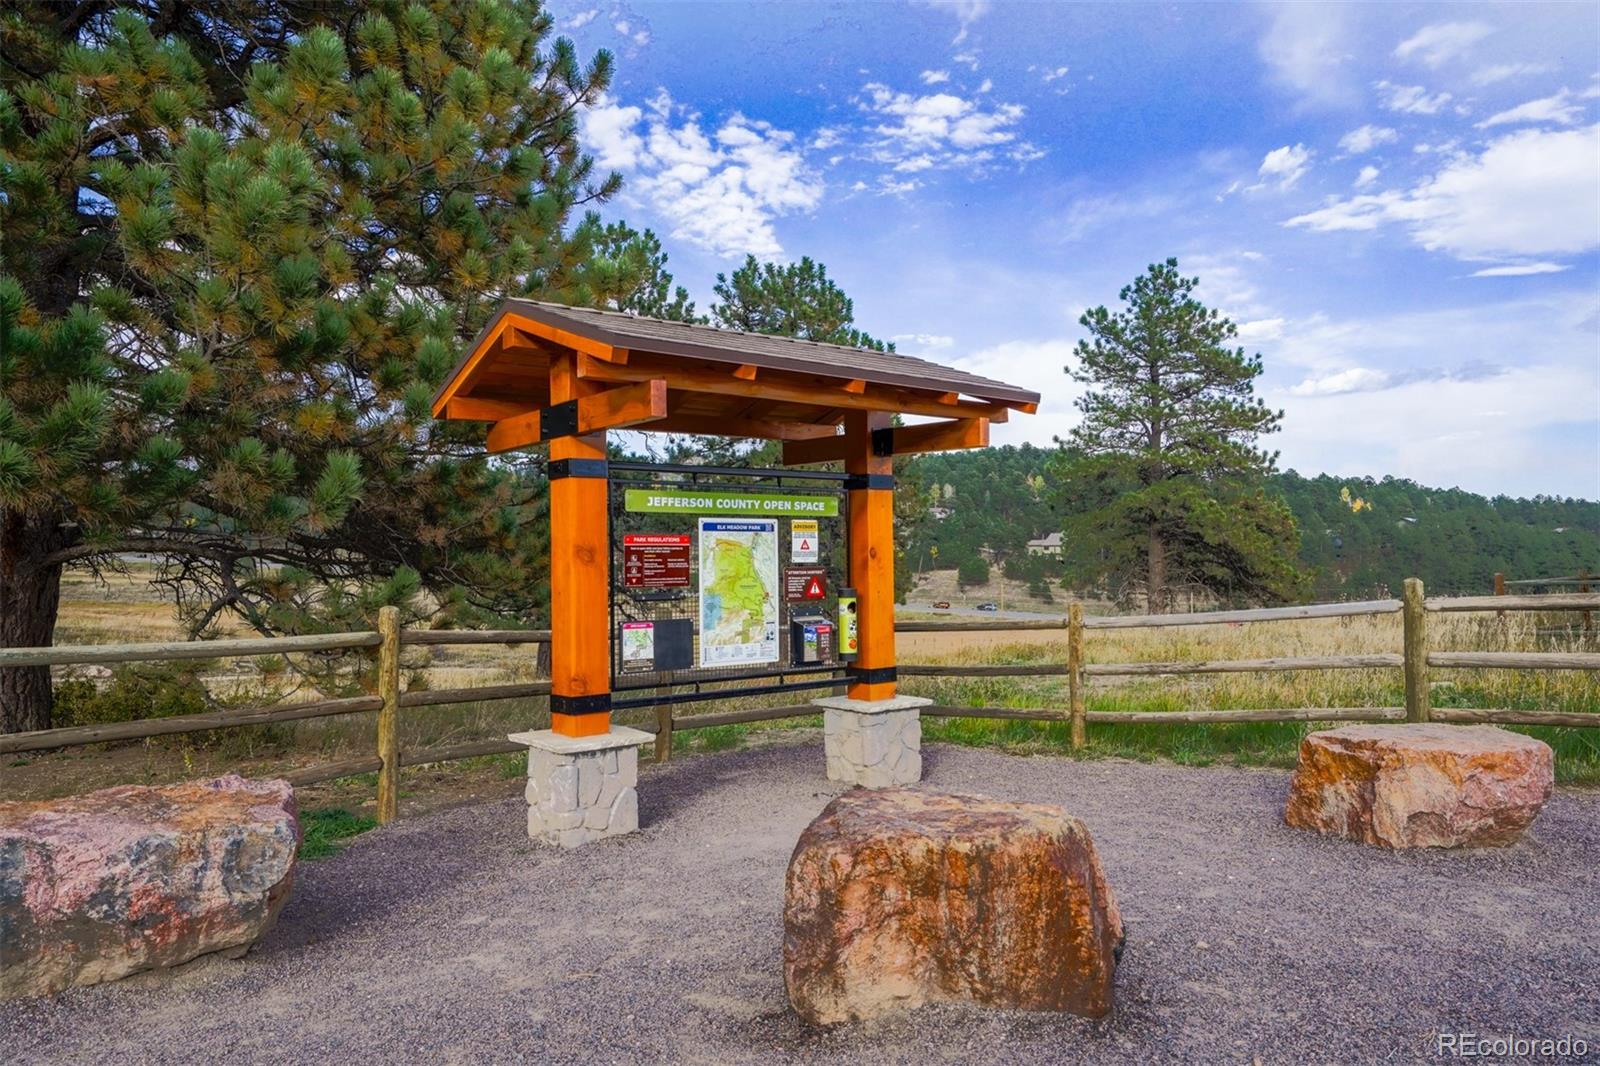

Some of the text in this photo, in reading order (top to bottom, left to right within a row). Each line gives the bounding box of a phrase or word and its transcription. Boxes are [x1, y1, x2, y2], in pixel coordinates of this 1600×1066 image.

[647, 496, 825, 511] JEFFERSON COUNTY OPEN SPACE
